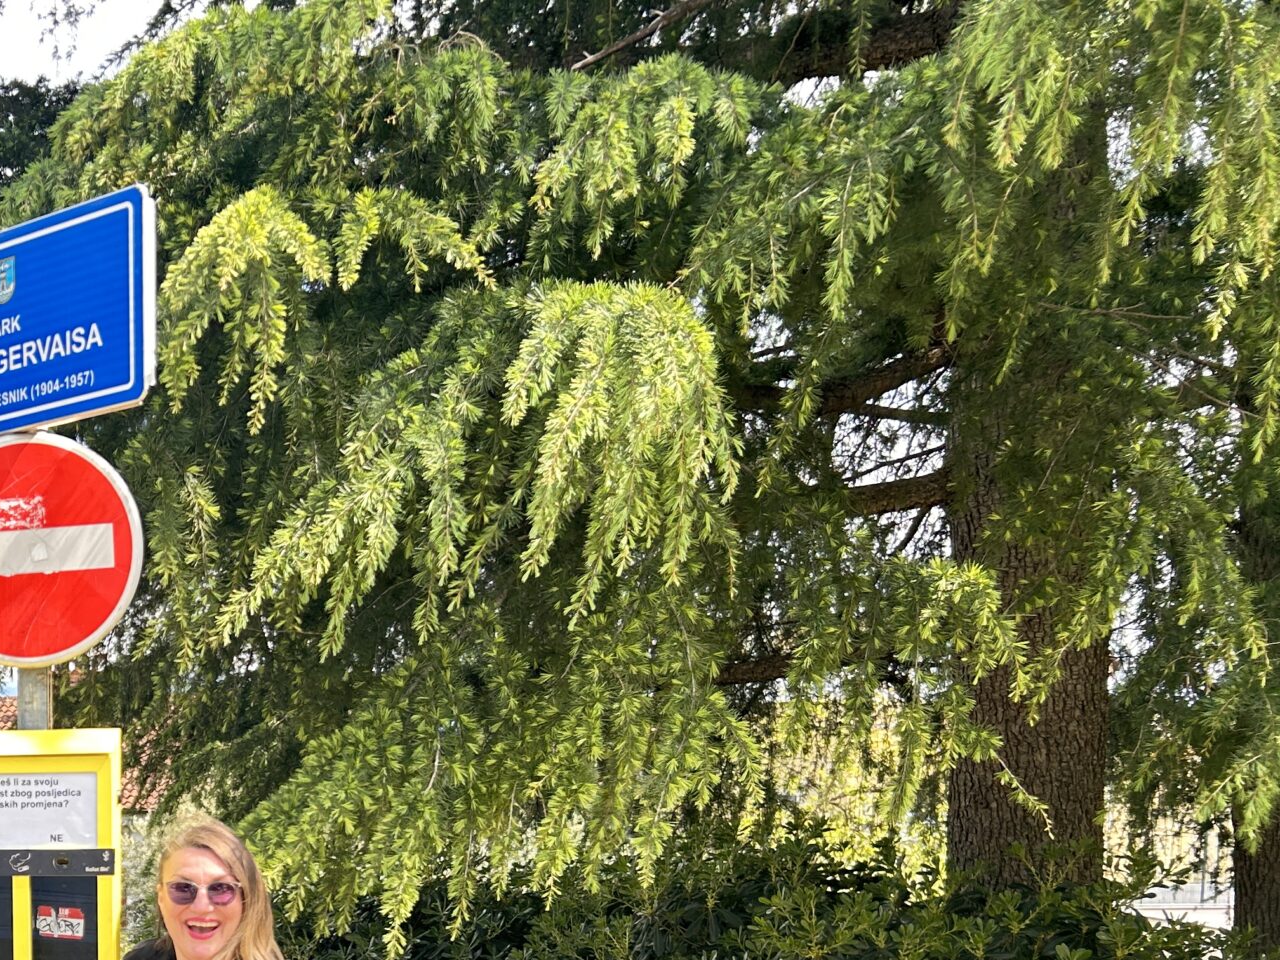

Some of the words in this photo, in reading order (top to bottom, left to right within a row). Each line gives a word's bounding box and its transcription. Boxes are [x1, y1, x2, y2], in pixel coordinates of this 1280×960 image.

[31, 370, 94, 401] (1904-1957)
[13, 777, 19, 786] li
[34, 778, 59, 788] svoju
[10, 788, 32, 800] zbog
[35, 788, 81, 799] posljedica
[21, 799, 69, 810] promjena?
[50, 834, 64, 843] NE
